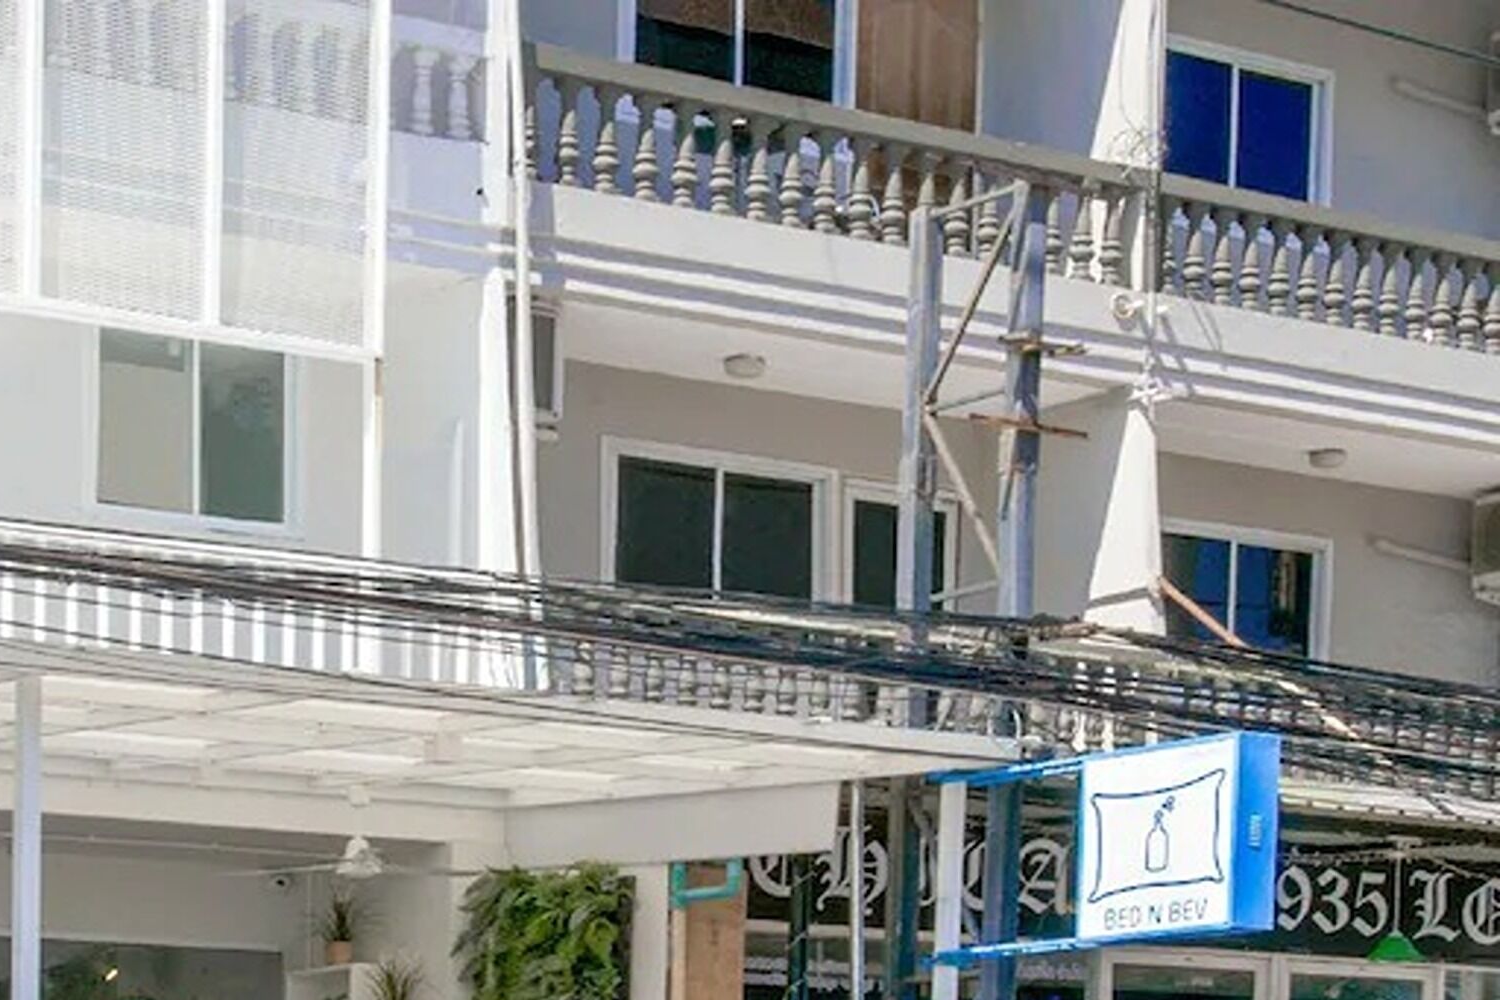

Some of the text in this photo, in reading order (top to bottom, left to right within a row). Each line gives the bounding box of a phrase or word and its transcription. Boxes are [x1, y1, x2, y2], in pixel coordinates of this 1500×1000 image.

[1104, 898, 1209, 931] BED N BEV
